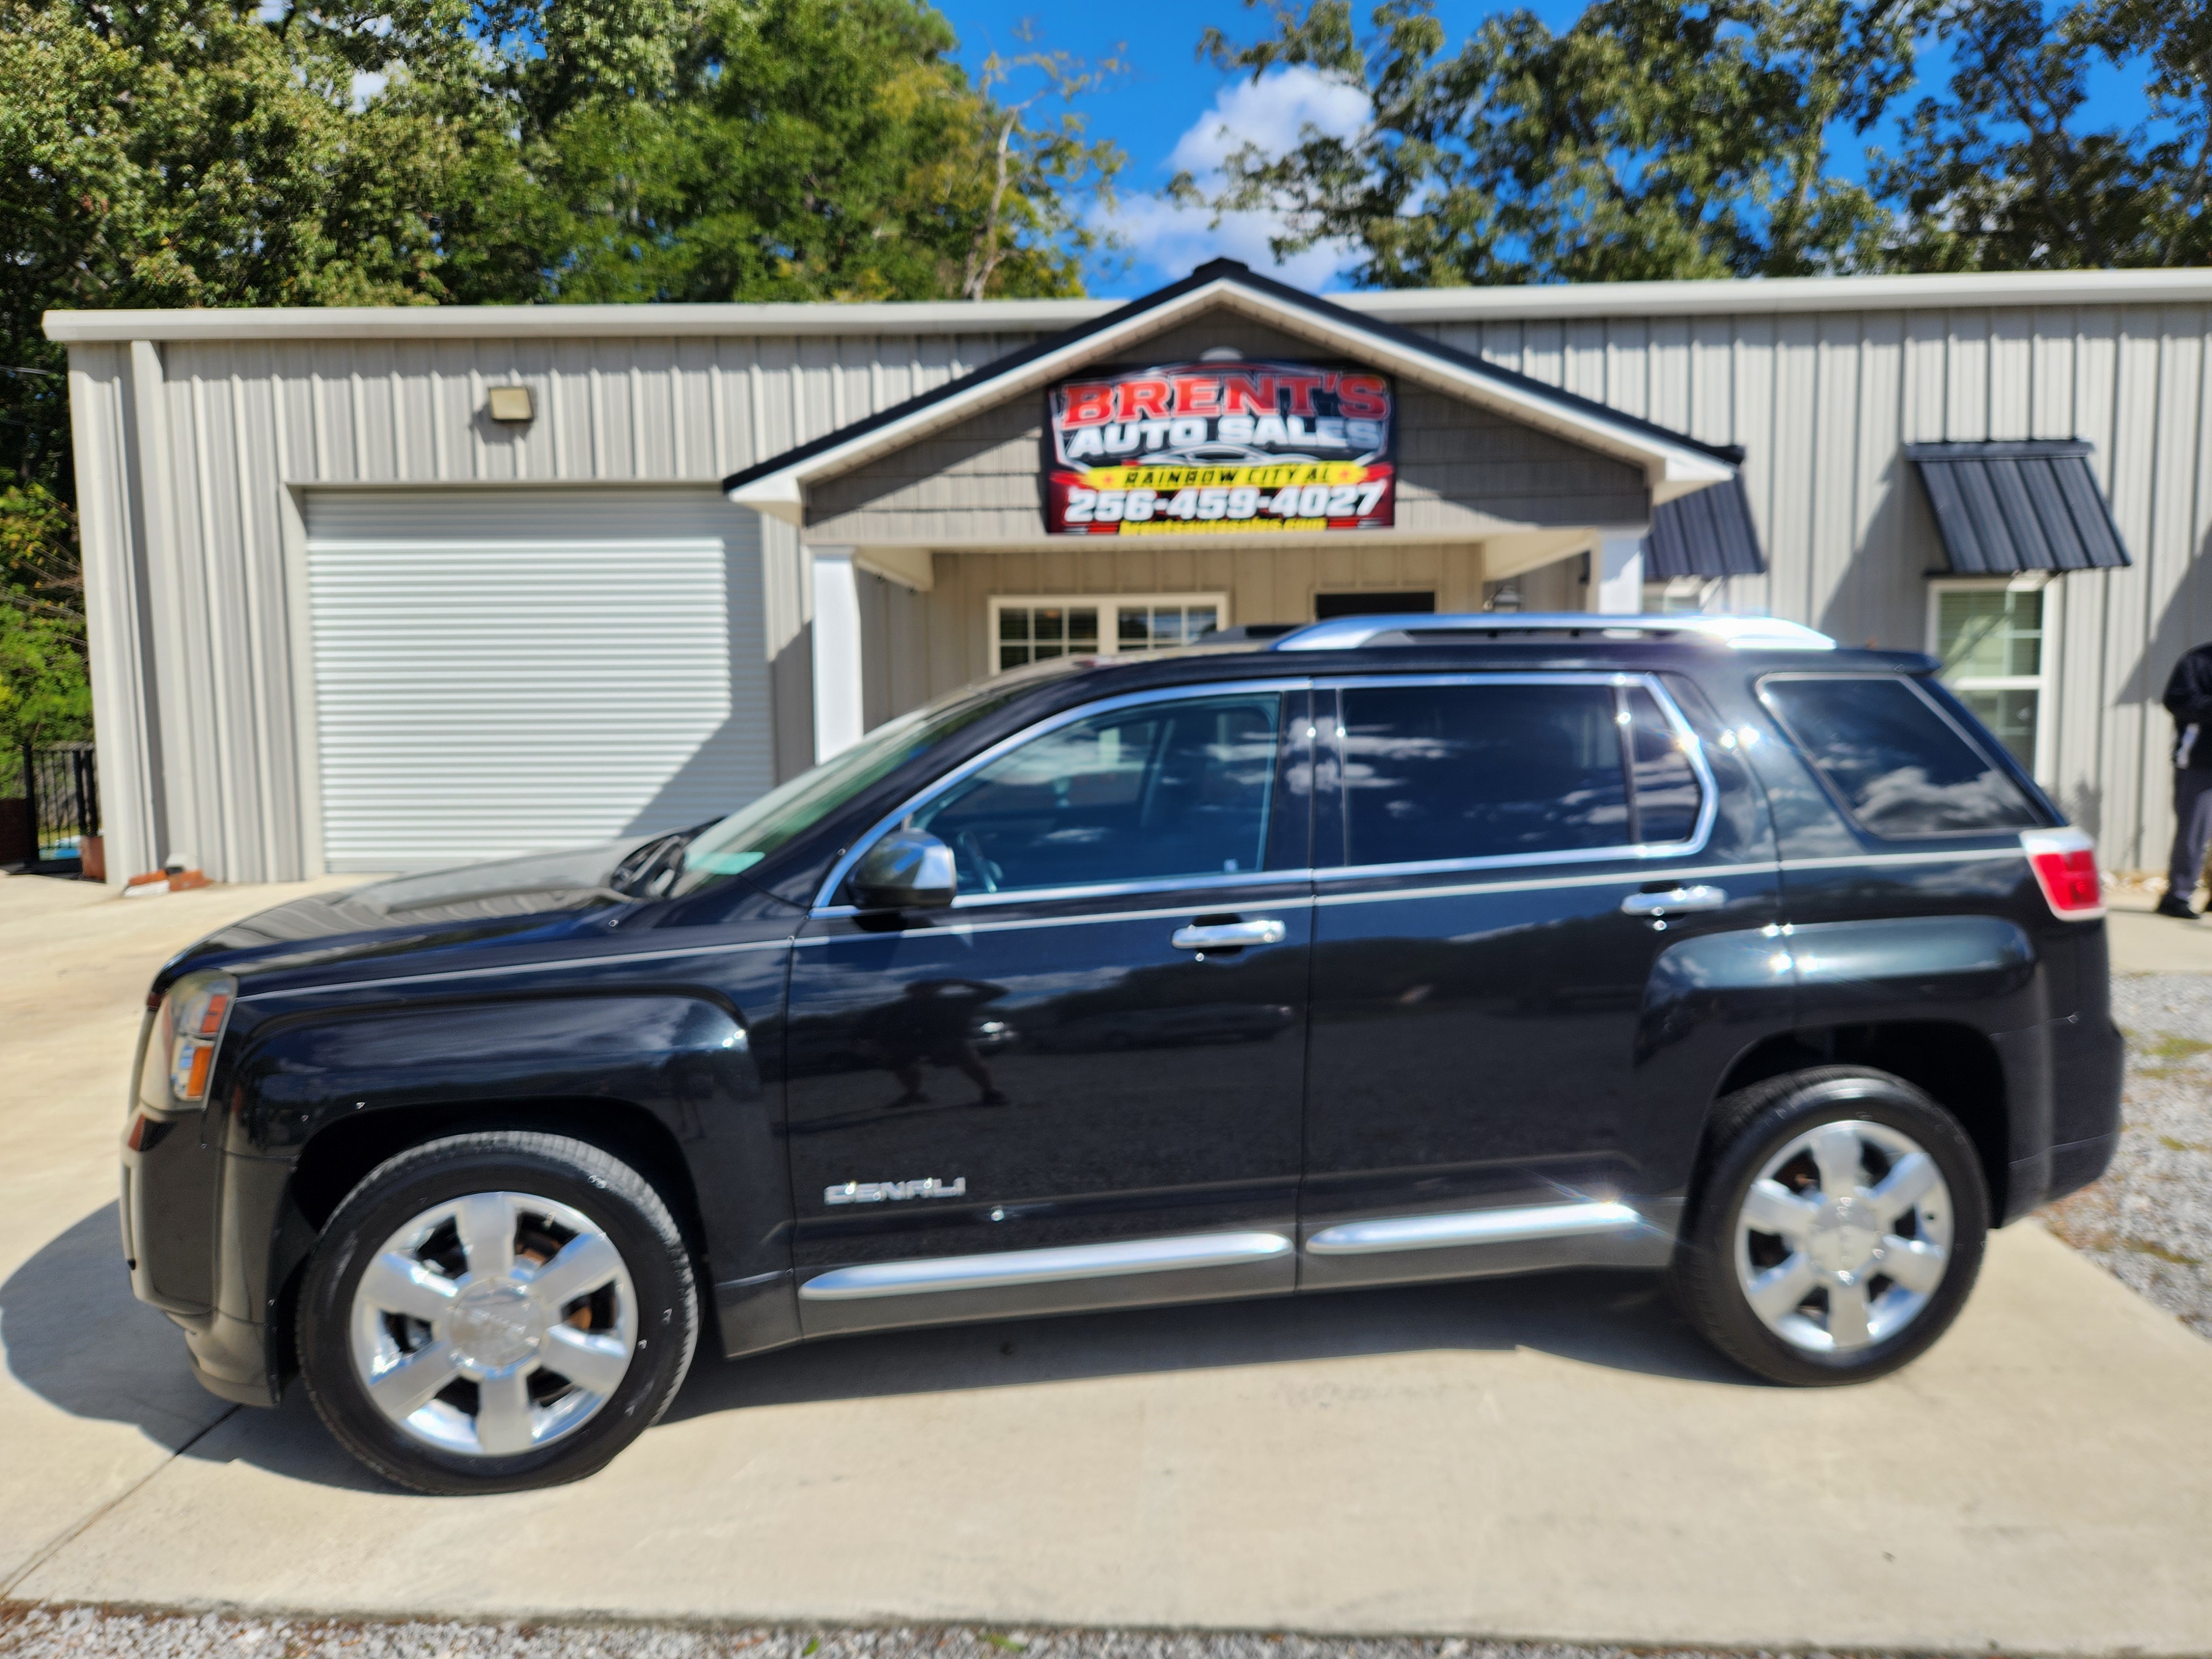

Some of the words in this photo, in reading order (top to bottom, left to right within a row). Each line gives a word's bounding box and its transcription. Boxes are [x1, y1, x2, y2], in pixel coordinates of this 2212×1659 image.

[1061, 373, 1389, 429] BRENT'S
[1066, 418, 1208, 458] AUTO
[1218, 415, 1380, 450] SALES
[1124, 469, 1238, 488] RAINBOW
[1247, 467, 1297, 483] CITY
[1305, 467, 1329, 482] AL
[1064, 486, 1384, 523] 256-459-4027
[824, 1177, 966, 1205] DENALI
